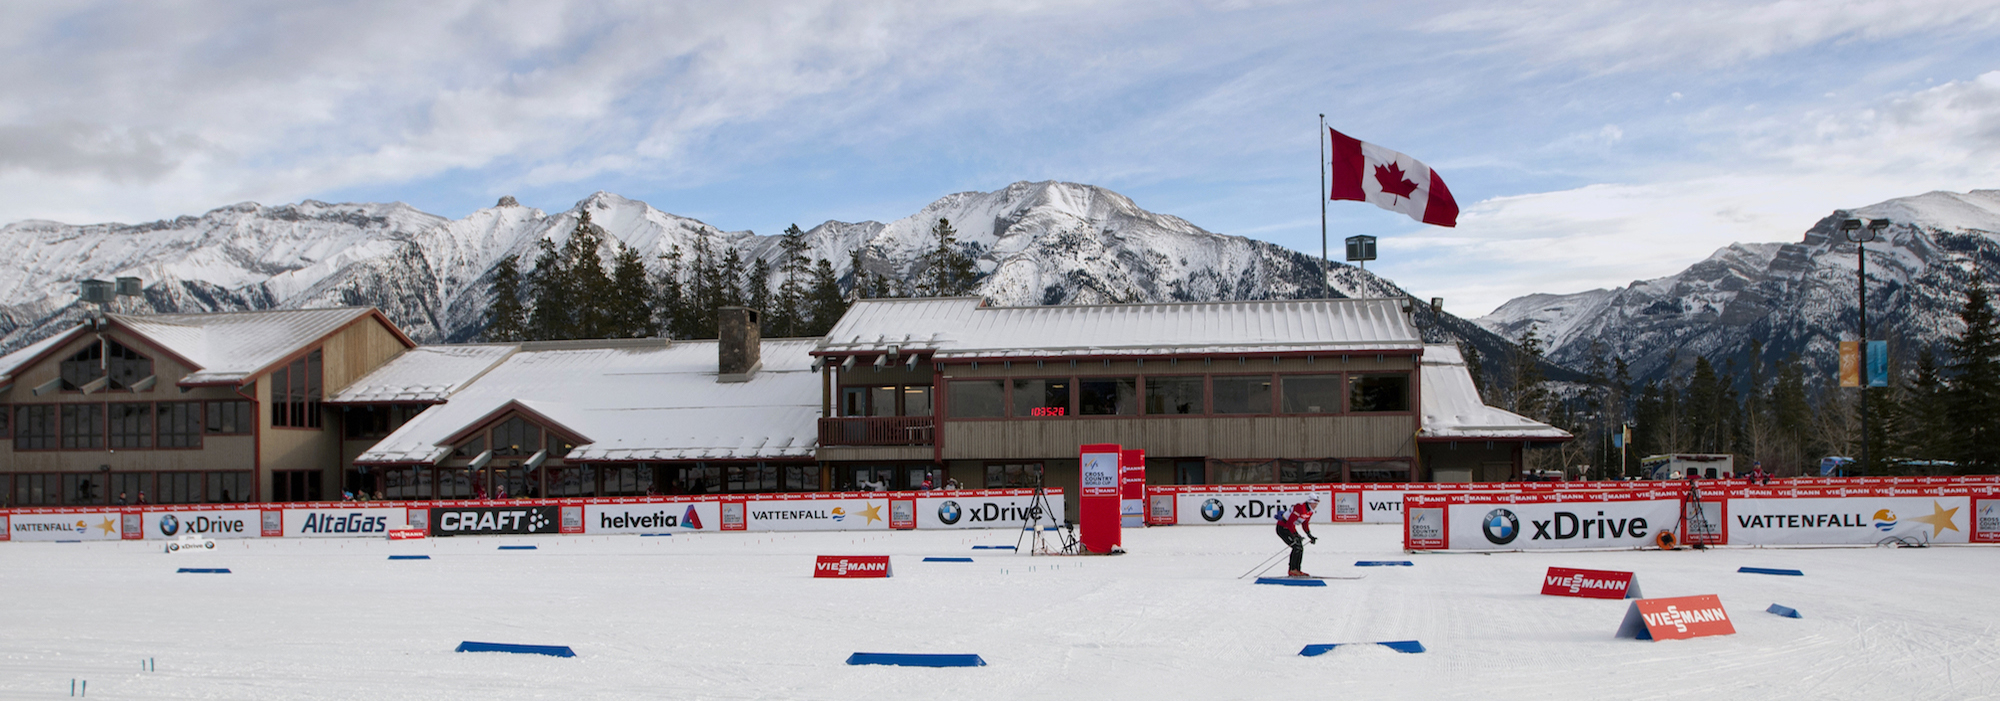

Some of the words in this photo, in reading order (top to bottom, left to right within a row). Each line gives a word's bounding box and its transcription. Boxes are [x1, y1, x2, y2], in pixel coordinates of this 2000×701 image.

[1085, 487, 1115, 495] VIESSMANN
[440, 511, 527, 531] CRAFT
[600, 510, 678, 529] helvetia
[752, 510, 828, 520] VATTENFALL
[969, 502, 1043, 522] xDrive
[1486, 510, 1516, 521] BMW
[1737, 514, 1867, 528] VATTENFALL
[14, 523, 73, 531] VATTENFALL
[185, 516, 244, 533] xDrive
[301, 512, 387, 533] AltaGas
[1531, 511, 1648, 540] xDrive
[817, 559, 886, 575] VIESSMANN
[1547, 573, 1627, 593] VIESSMANN
[1643, 605, 1726, 633] VIESSMANN
